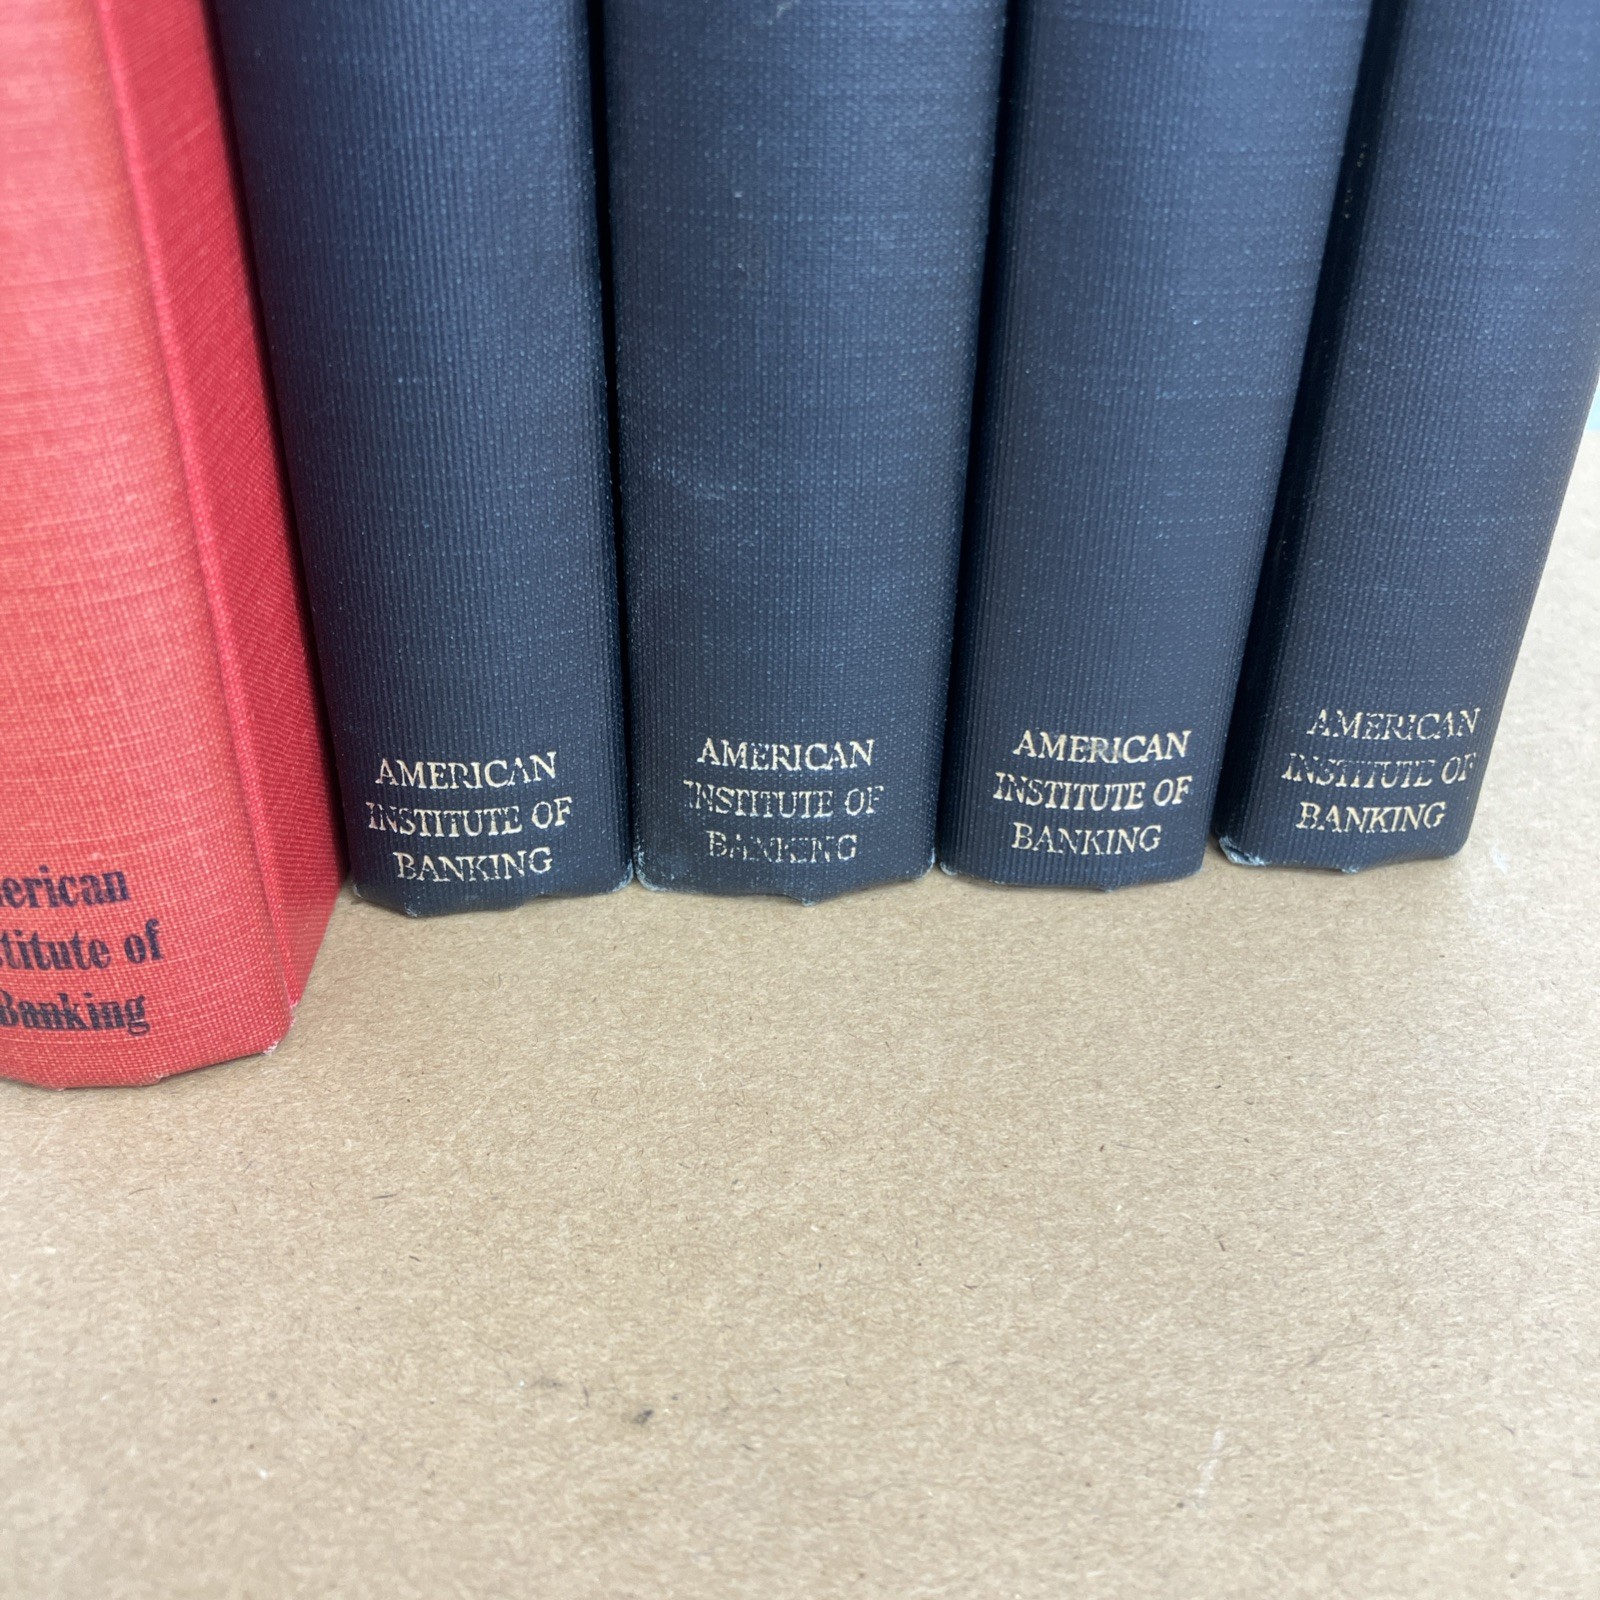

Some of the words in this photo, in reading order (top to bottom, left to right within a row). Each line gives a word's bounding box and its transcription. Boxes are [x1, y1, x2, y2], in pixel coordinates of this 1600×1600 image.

[696, 737, 875, 771] AMERICAN
[1013, 730, 1192, 764] AMERICAN
[375, 752, 556, 789] AMERICAN
[844, 785, 884, 816] OF
[993, 772, 1146, 811] INSTITUTE
[1153, 775, 1193, 806] OF
[365, 801, 522, 837] INSTITUTE
[531, 796, 573, 829] OF
[1296, 801, 1446, 834] BANKING
[1011, 822, 1162, 855] BANKING
[392, 847, 553, 882] BANKING
[0, 865, 130, 908] erican
[0, 930, 111, 970] titute
[124, 918, 163, 964] of
